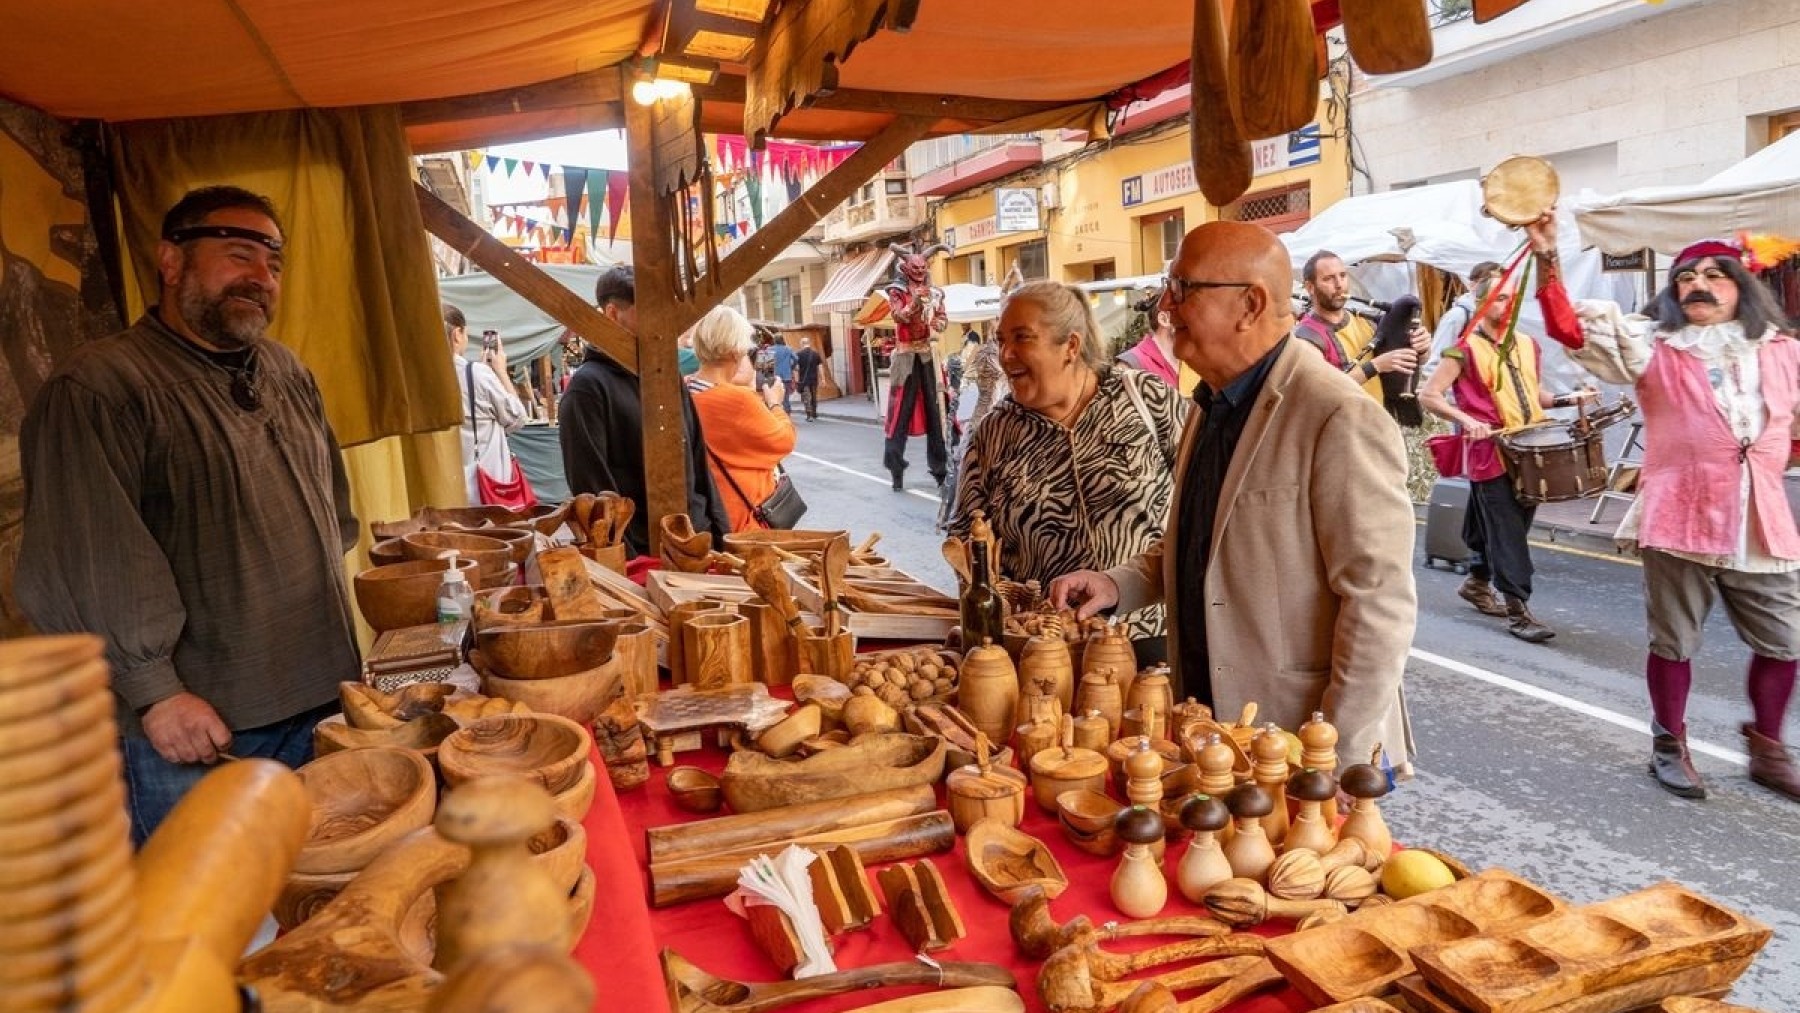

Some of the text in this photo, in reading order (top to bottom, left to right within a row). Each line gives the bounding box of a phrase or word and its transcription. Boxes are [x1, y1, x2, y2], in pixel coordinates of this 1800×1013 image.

[1153, 142, 1276, 195] AUTOSER NEZ
[1124, 178, 1141, 204] FM
